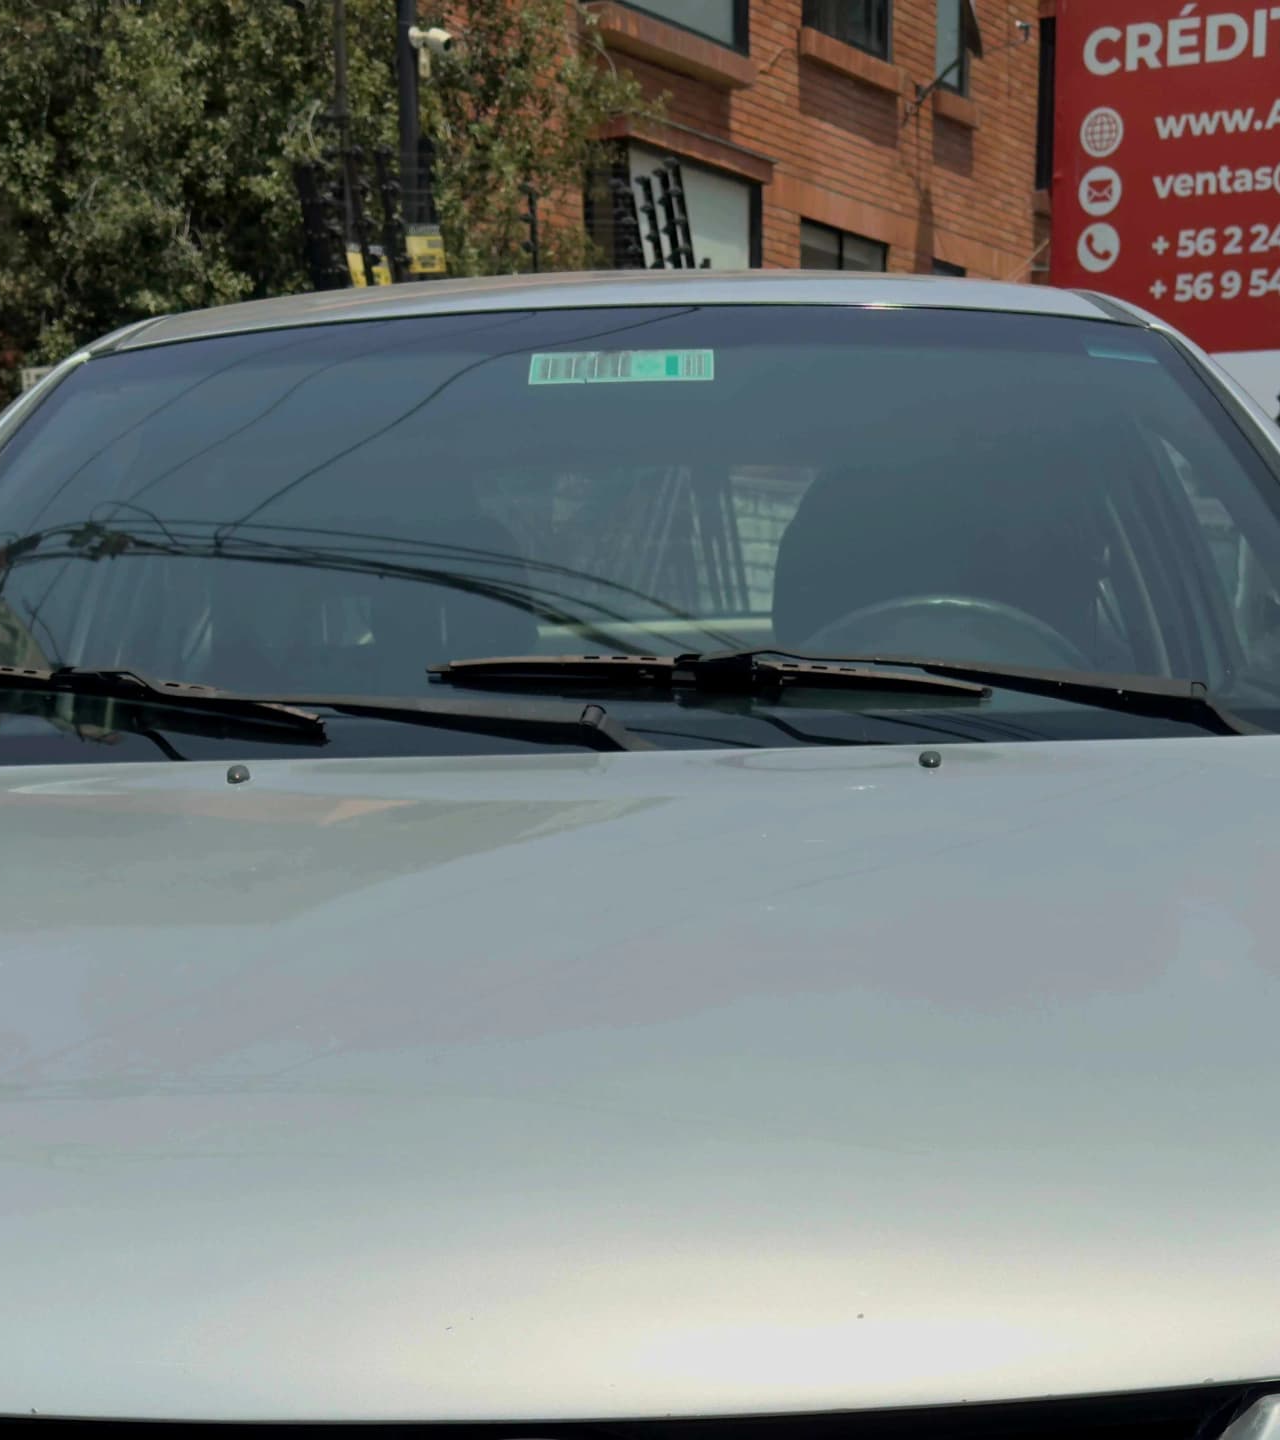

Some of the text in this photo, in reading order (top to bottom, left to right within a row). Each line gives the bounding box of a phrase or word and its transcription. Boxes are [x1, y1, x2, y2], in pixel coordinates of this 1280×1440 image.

[1176, 227, 1217, 258] 56
[1222, 225, 1243, 255] 2
[1174, 272, 1214, 302] 56
[1220, 270, 1242, 299] 9
